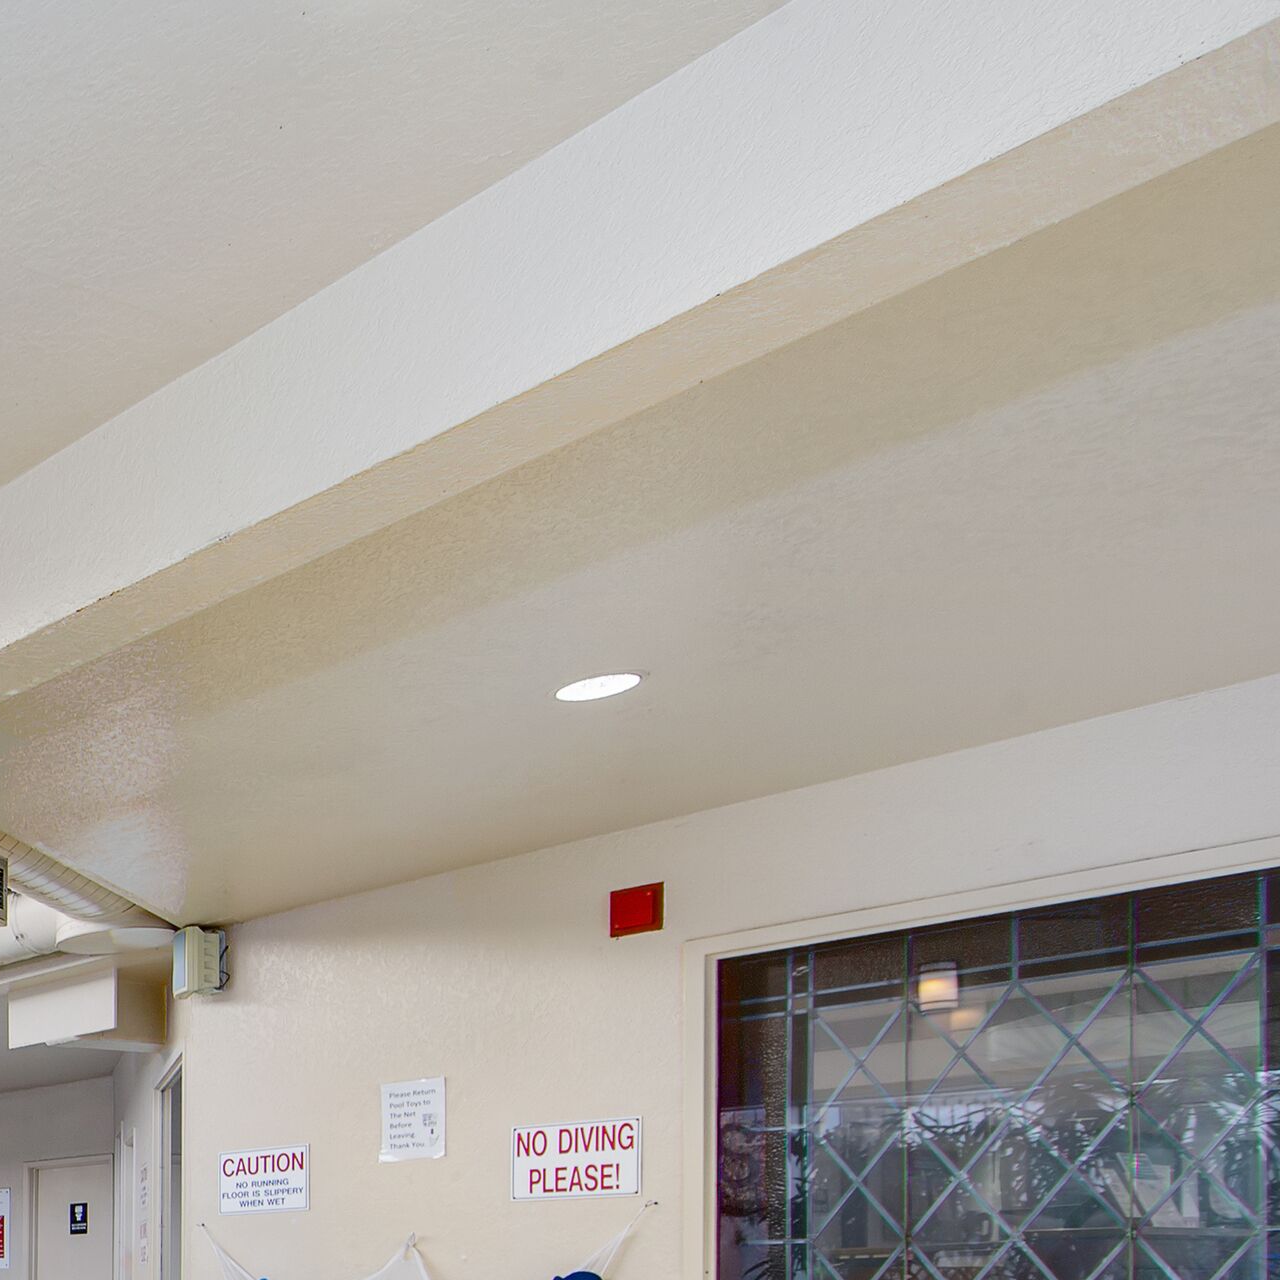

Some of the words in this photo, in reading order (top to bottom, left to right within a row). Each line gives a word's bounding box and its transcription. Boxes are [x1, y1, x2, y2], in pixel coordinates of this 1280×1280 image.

[517, 1130, 547, 1157] NO
[558, 1123, 634, 1154] DIVING
[222, 1152, 304, 1177] CAUTION
[236, 1181, 248, 1189] NO
[251, 1178, 289, 1188] RUNNING
[529, 1163, 620, 1194] PLEASE!
[222, 1190, 249, 1199] FLOOR
[252, 1189, 260, 1197] IS
[264, 1187, 303, 1197] SLIPPERY
[240, 1199, 264, 1207] WHEN
[267, 1198, 285, 1206] WET
